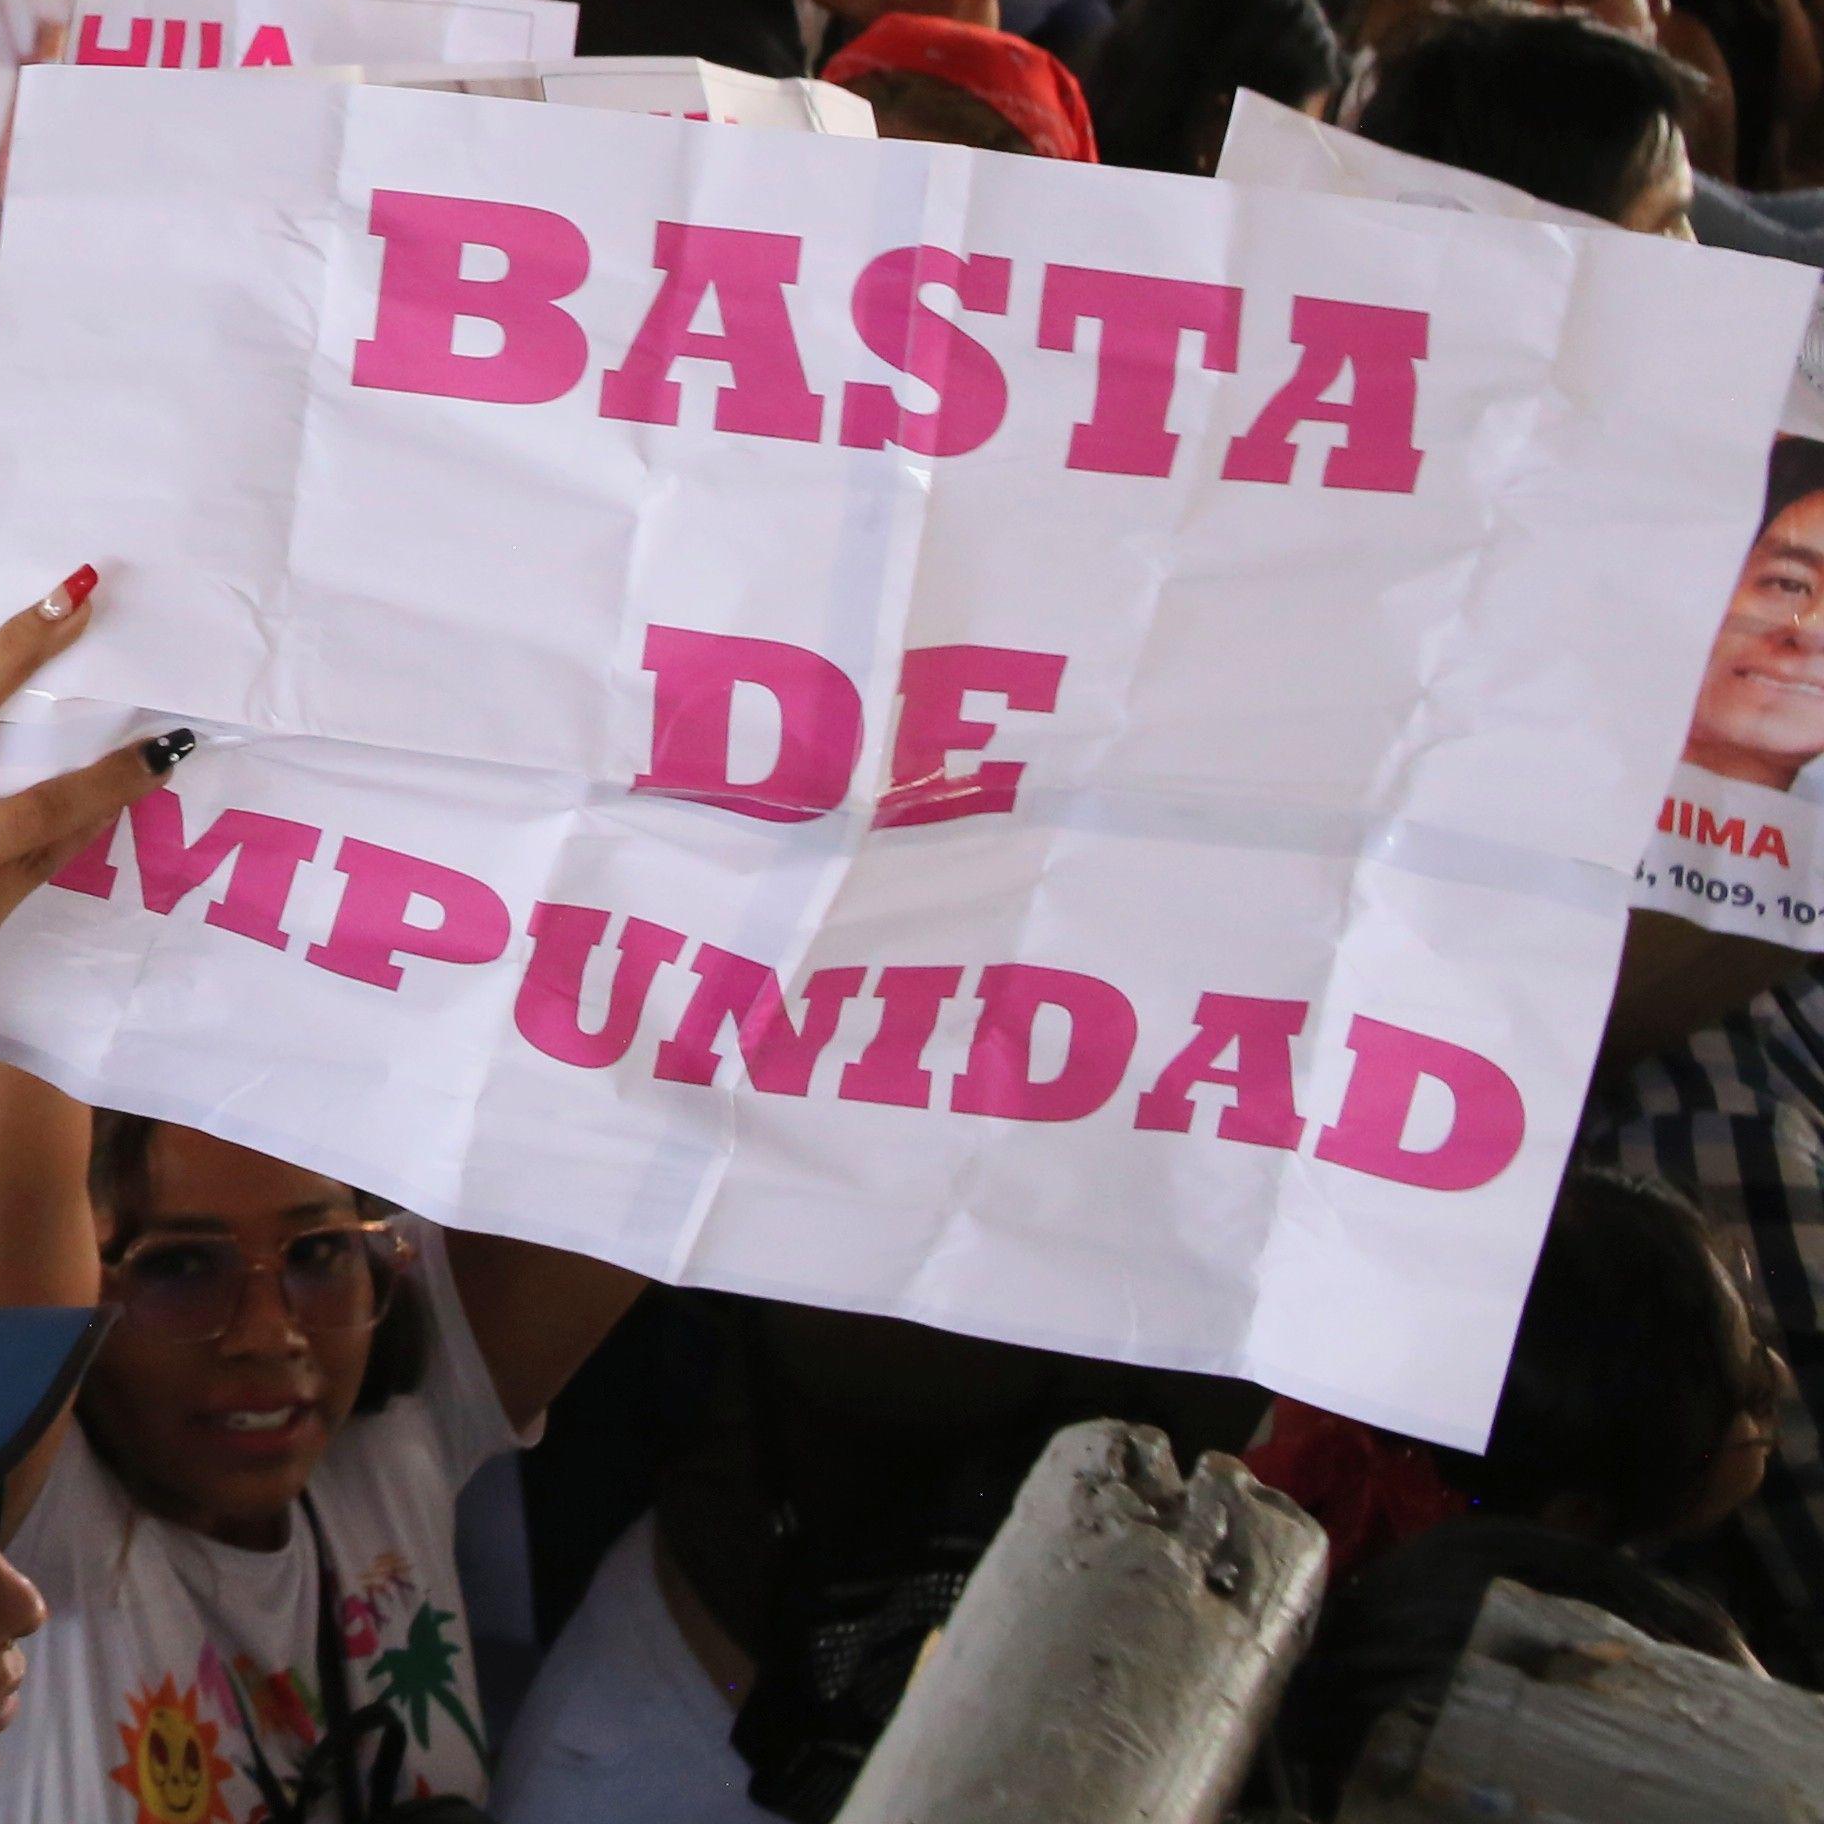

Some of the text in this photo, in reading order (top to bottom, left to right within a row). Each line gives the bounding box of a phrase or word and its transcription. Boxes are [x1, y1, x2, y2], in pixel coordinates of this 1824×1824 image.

[352, 187, 1430, 496] BASTA
[631, 623, 1068, 831] DE
[48, 785, 1527, 1194] MPUNIDAD
[1668, 862, 1767, 917] 1009,
